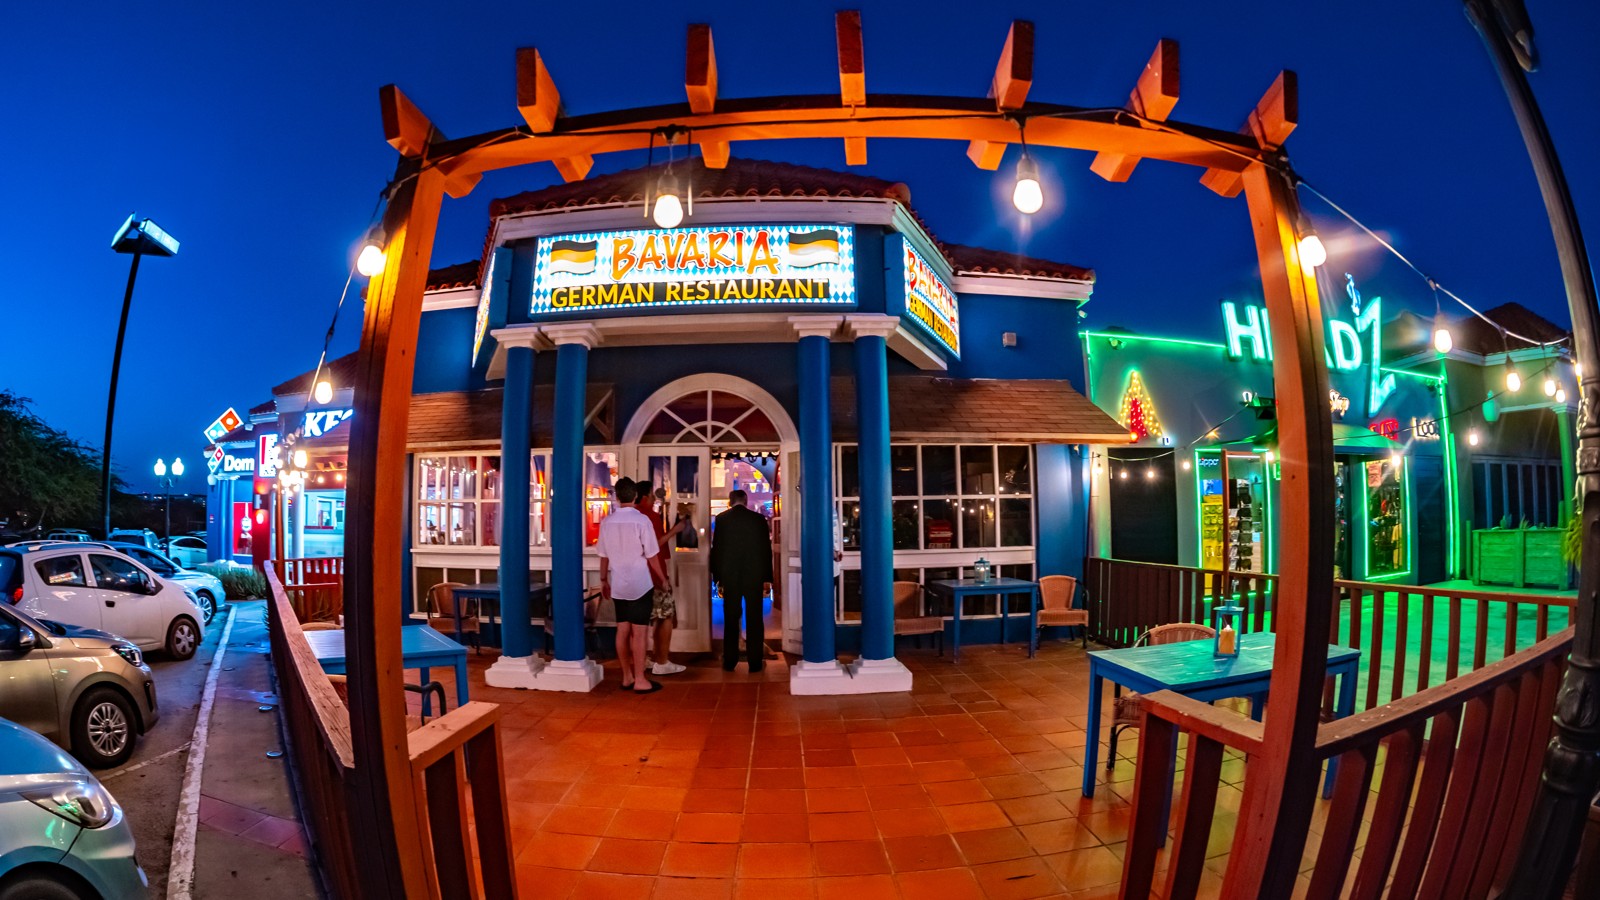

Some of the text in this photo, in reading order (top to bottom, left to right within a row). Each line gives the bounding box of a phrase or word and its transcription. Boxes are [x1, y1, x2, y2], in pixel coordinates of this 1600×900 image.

[612, 231, 779, 280] BAVARIA
[551, 278, 829, 308] GERMAN RESTAURANT
